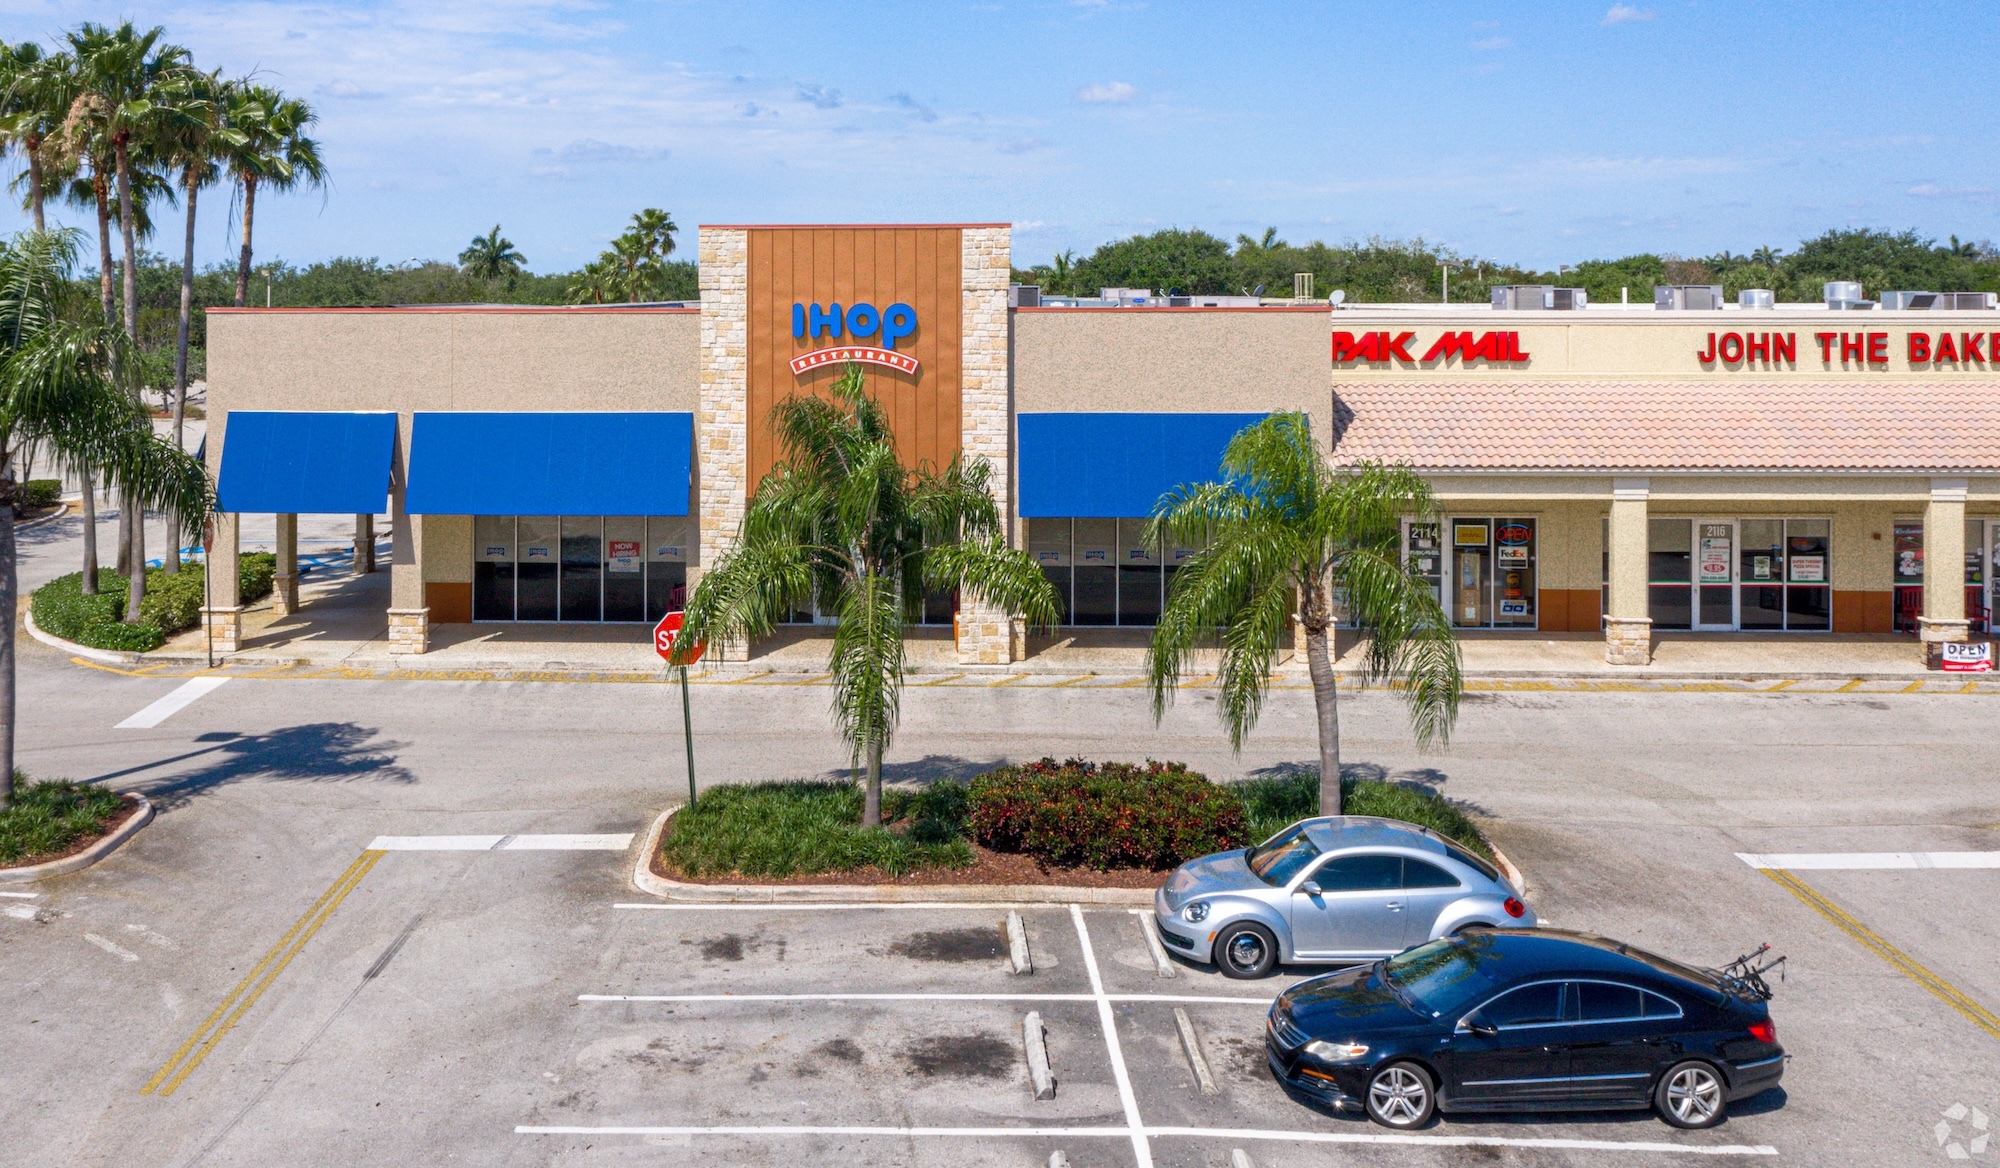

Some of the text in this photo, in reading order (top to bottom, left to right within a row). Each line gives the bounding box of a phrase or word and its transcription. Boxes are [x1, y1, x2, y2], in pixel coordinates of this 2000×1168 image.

[792, 303, 917, 350] IHOP
[1332, 332, 1530, 361] PAK MAIL
[1698, 332, 1796, 362] JOHN
[1817, 332, 1888, 362] THE
[798, 351, 910, 369] RESTAURANT
[1411, 527, 1438, 539] 2114
[1496, 527, 1533, 542] OPEN
[1707, 525, 1726, 537] 2116
[614, 542, 633, 550] NOW
[612, 549, 637, 558] HIRING
[1501, 550, 1525, 558] FedEx
[658, 630, 699, 651] ST
[1948, 643, 1986, 655] OPEN
